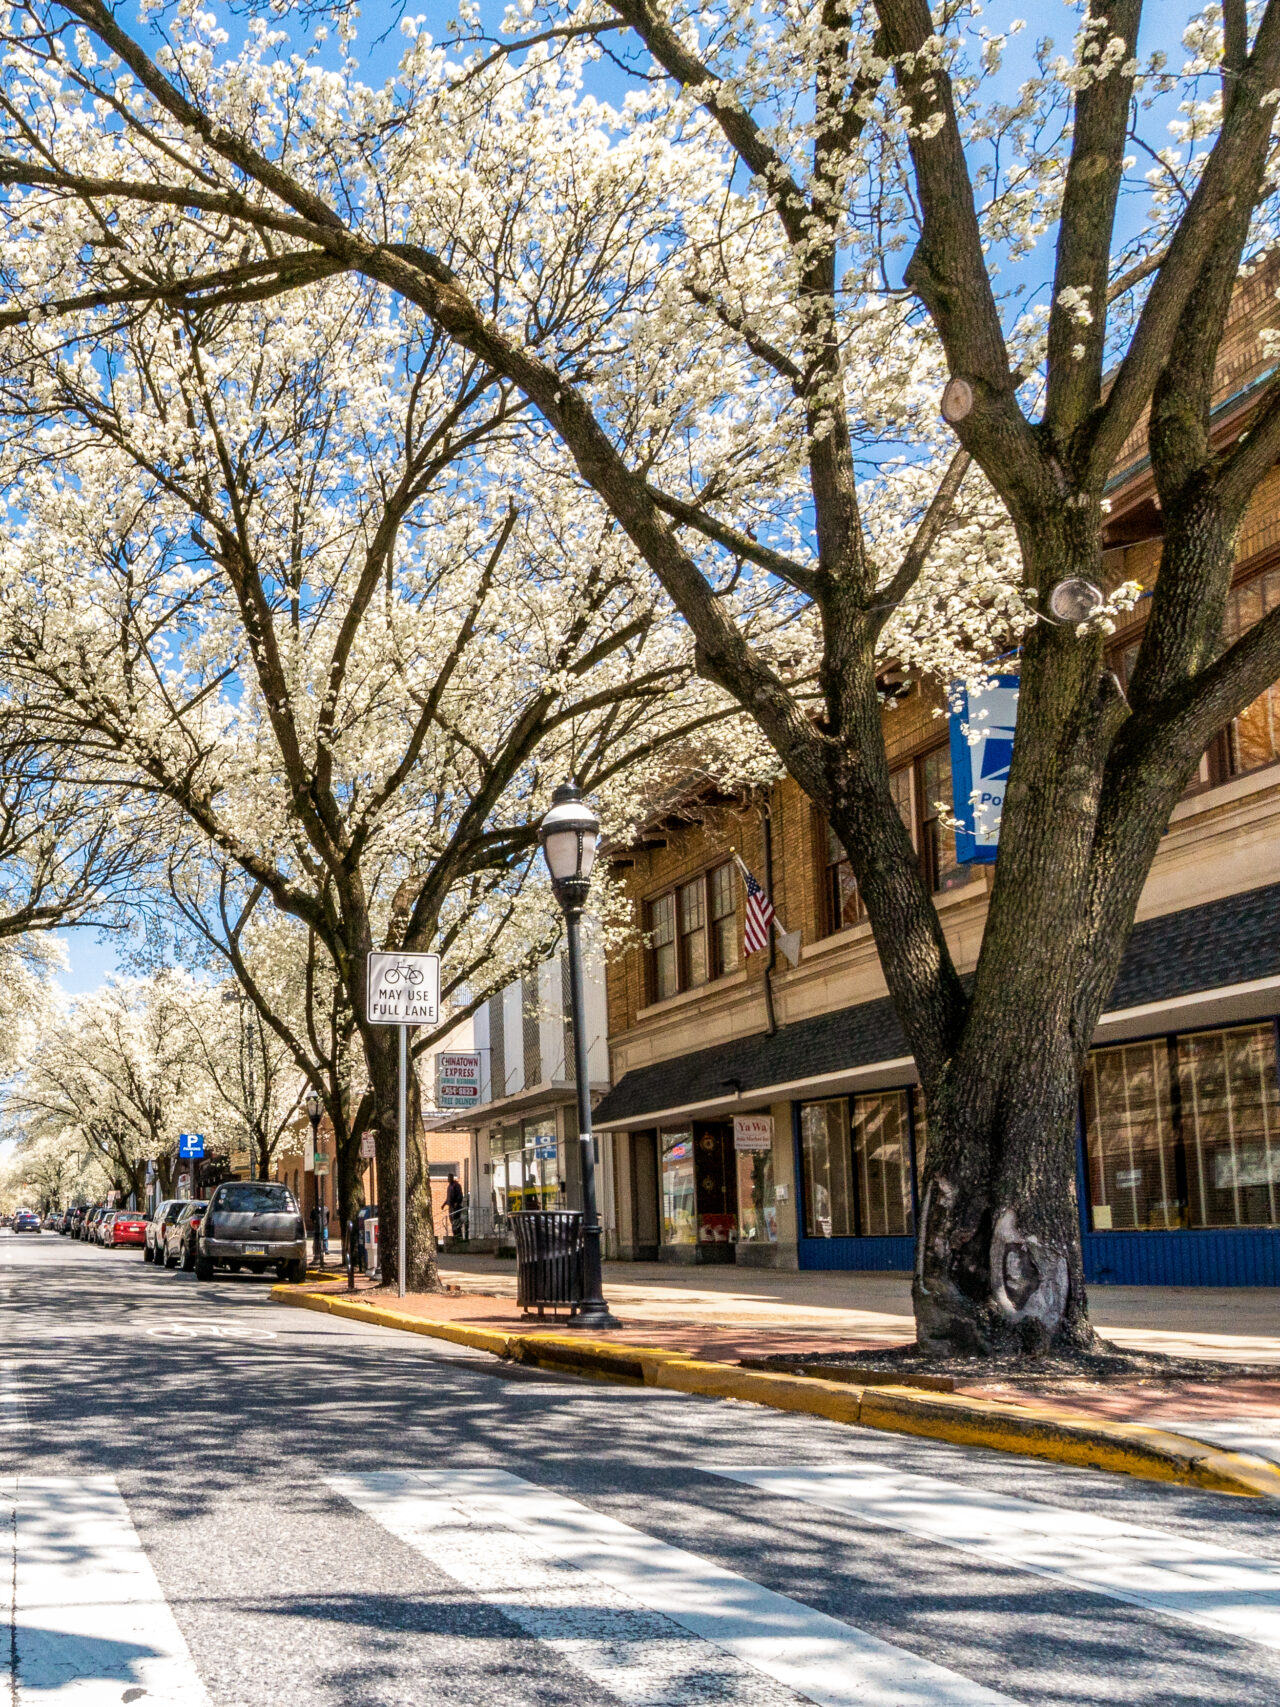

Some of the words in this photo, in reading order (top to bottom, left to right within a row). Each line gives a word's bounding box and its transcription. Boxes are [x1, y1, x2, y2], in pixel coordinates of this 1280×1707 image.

[981, 793, 1001, 806] Po
[380, 989, 402, 999] MAY
[408, 991, 429, 1001] USE
[374, 1004, 399, 1015] FULL
[405, 1005, 434, 1016] LANE
[442, 1057, 478, 1067] CHINATOWN
[445, 1068, 474, 1077] EXPRESS
[738, 1122, 750, 1131] Ya
[752, 1122, 767, 1131] Wa
[187, 1135, 198, 1148] P
